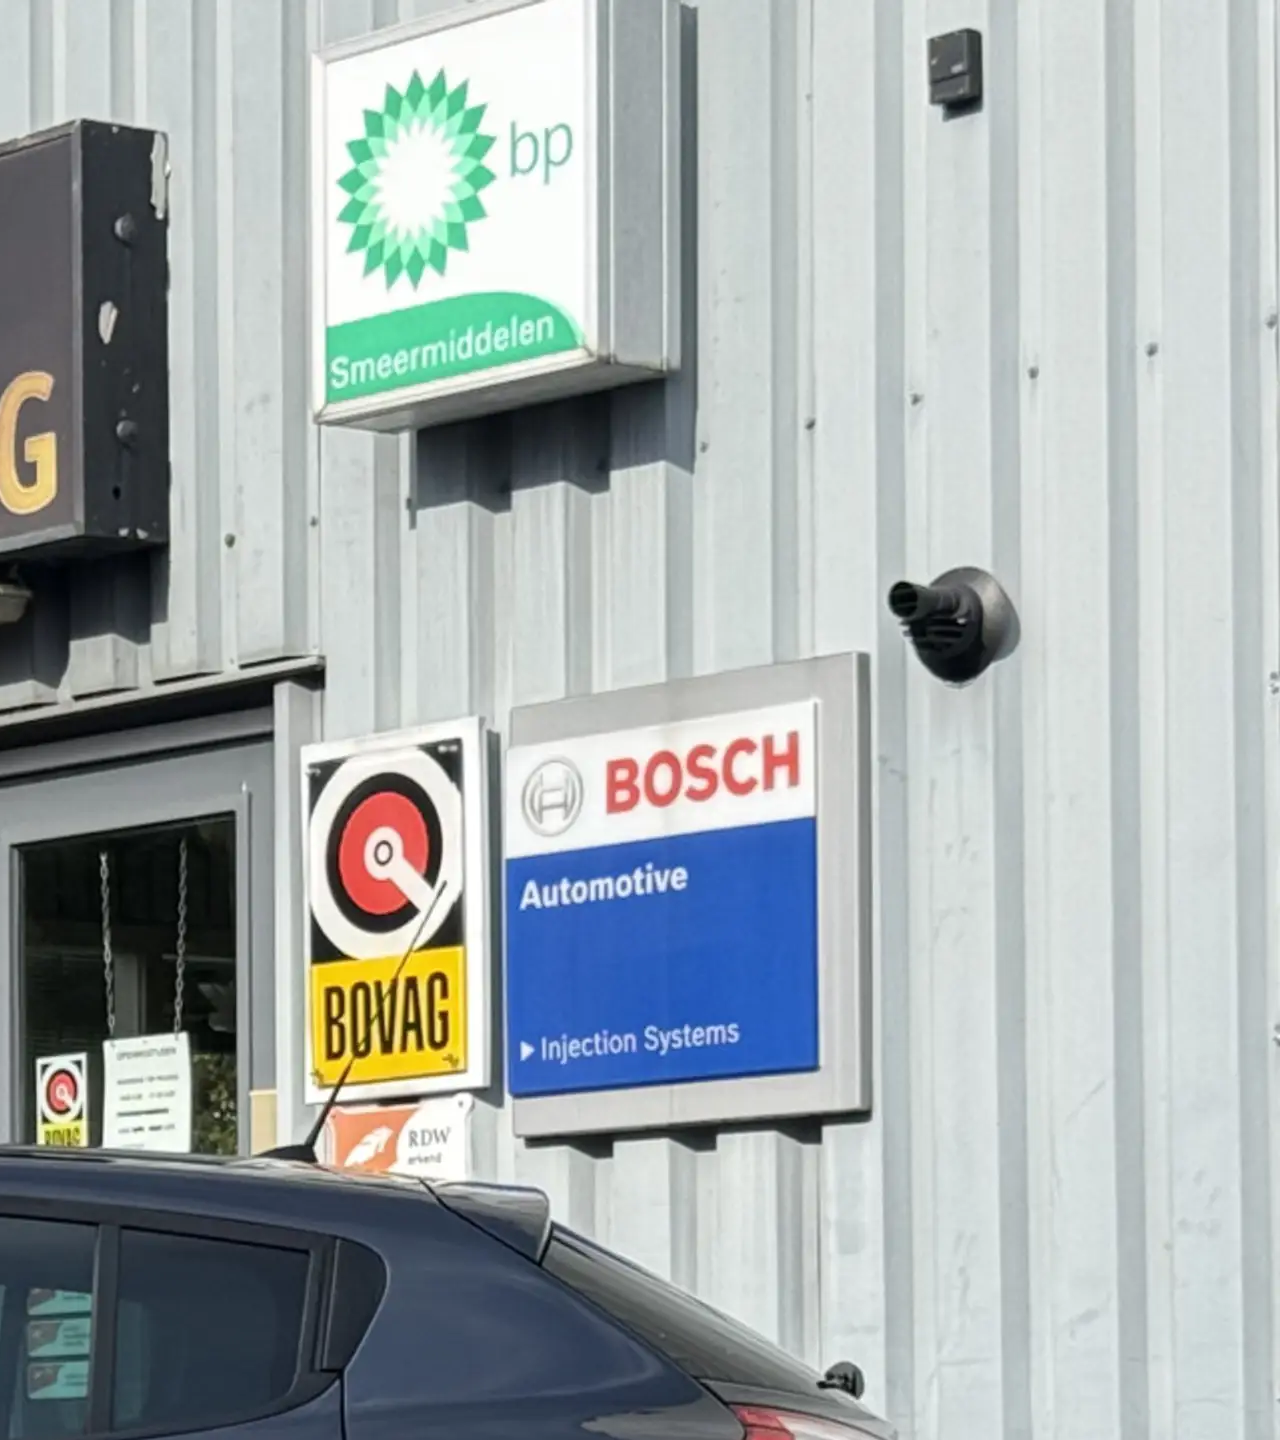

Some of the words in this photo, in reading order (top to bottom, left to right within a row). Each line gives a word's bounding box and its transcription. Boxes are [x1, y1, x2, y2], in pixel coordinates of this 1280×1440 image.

[509, 121, 573, 184] bp
[330, 314, 554, 389] Smeermiddelen
[606, 731, 800, 813] BOSCH
[520, 863, 688, 911] Automotive
[325, 971, 449, 1060] BOVAG
[540, 1028, 636, 1063] Injection
[644, 1020, 740, 1053] Systems
[407, 1127, 451, 1148] RDW
